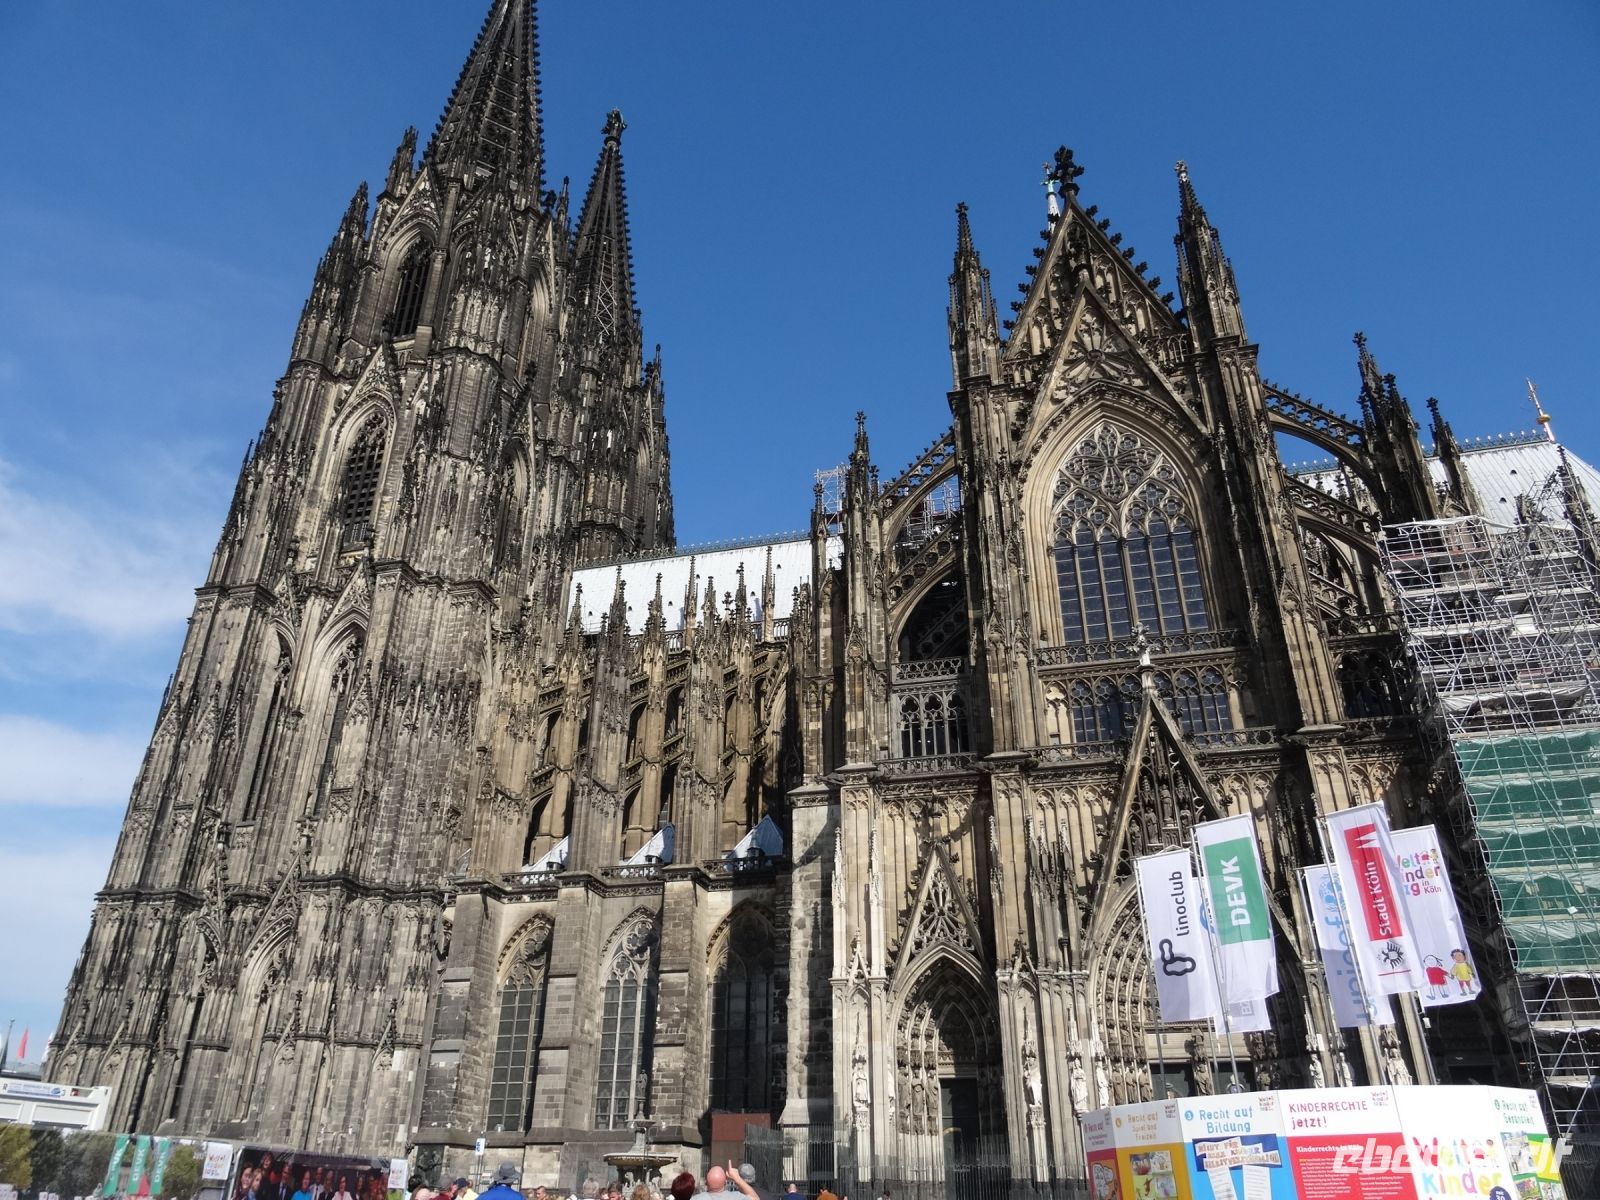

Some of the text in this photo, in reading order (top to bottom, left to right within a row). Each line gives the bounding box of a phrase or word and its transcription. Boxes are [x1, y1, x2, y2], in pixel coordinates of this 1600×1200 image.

[1402, 866, 1440, 882] inder
[1220, 855, 1251, 927] DEVK
[1424, 885, 1442, 894] Köln
[1169, 870, 1189, 937] linoclub
[1367, 861, 1392, 937] Stadt Köln
[1199, 1109, 1230, 1121] Recht
[1234, 1105, 1253, 1118] auf
[1289, 1100, 1368, 1113] KINDERRECHTE
[1207, 1121, 1251, 1134] Bildung
[1292, 1116, 1328, 1130] jetzt!
[1296, 1145, 1340, 1153] Kinderrechte
[1412, 1136, 1471, 1167] Welt
[133, 1148, 145, 1181] DEVK
[1422, 1168, 1502, 1196] Kinder
